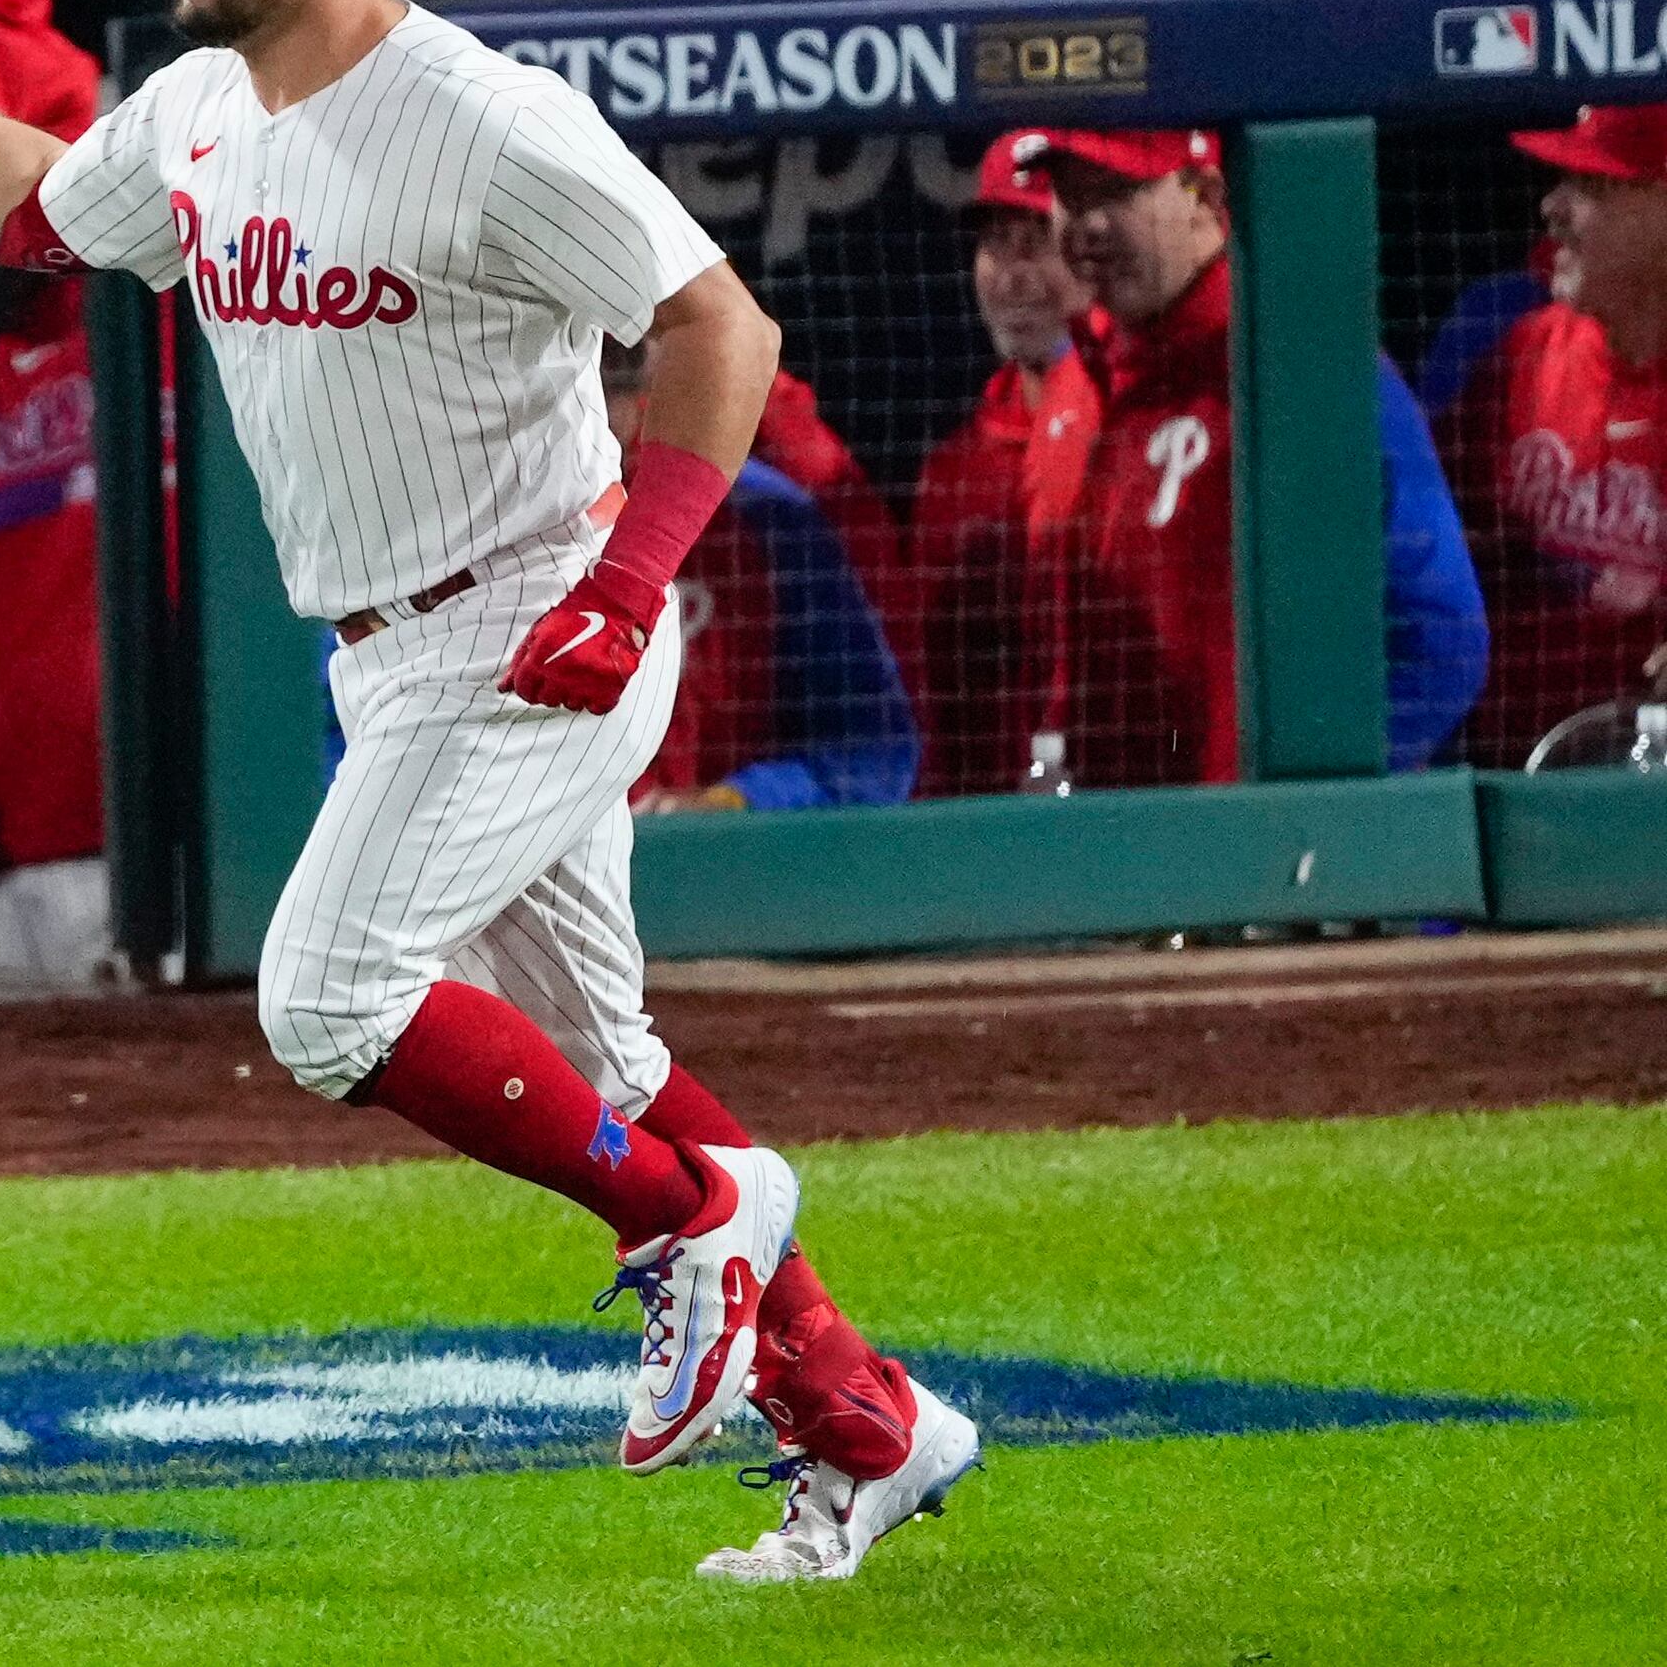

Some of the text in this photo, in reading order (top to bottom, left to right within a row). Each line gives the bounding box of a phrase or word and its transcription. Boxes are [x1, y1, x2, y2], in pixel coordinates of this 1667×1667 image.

[973, 32, 1149, 83] 2023
[169, 189, 420, 331] Phillies
[1145, 415, 1212, 529] P
